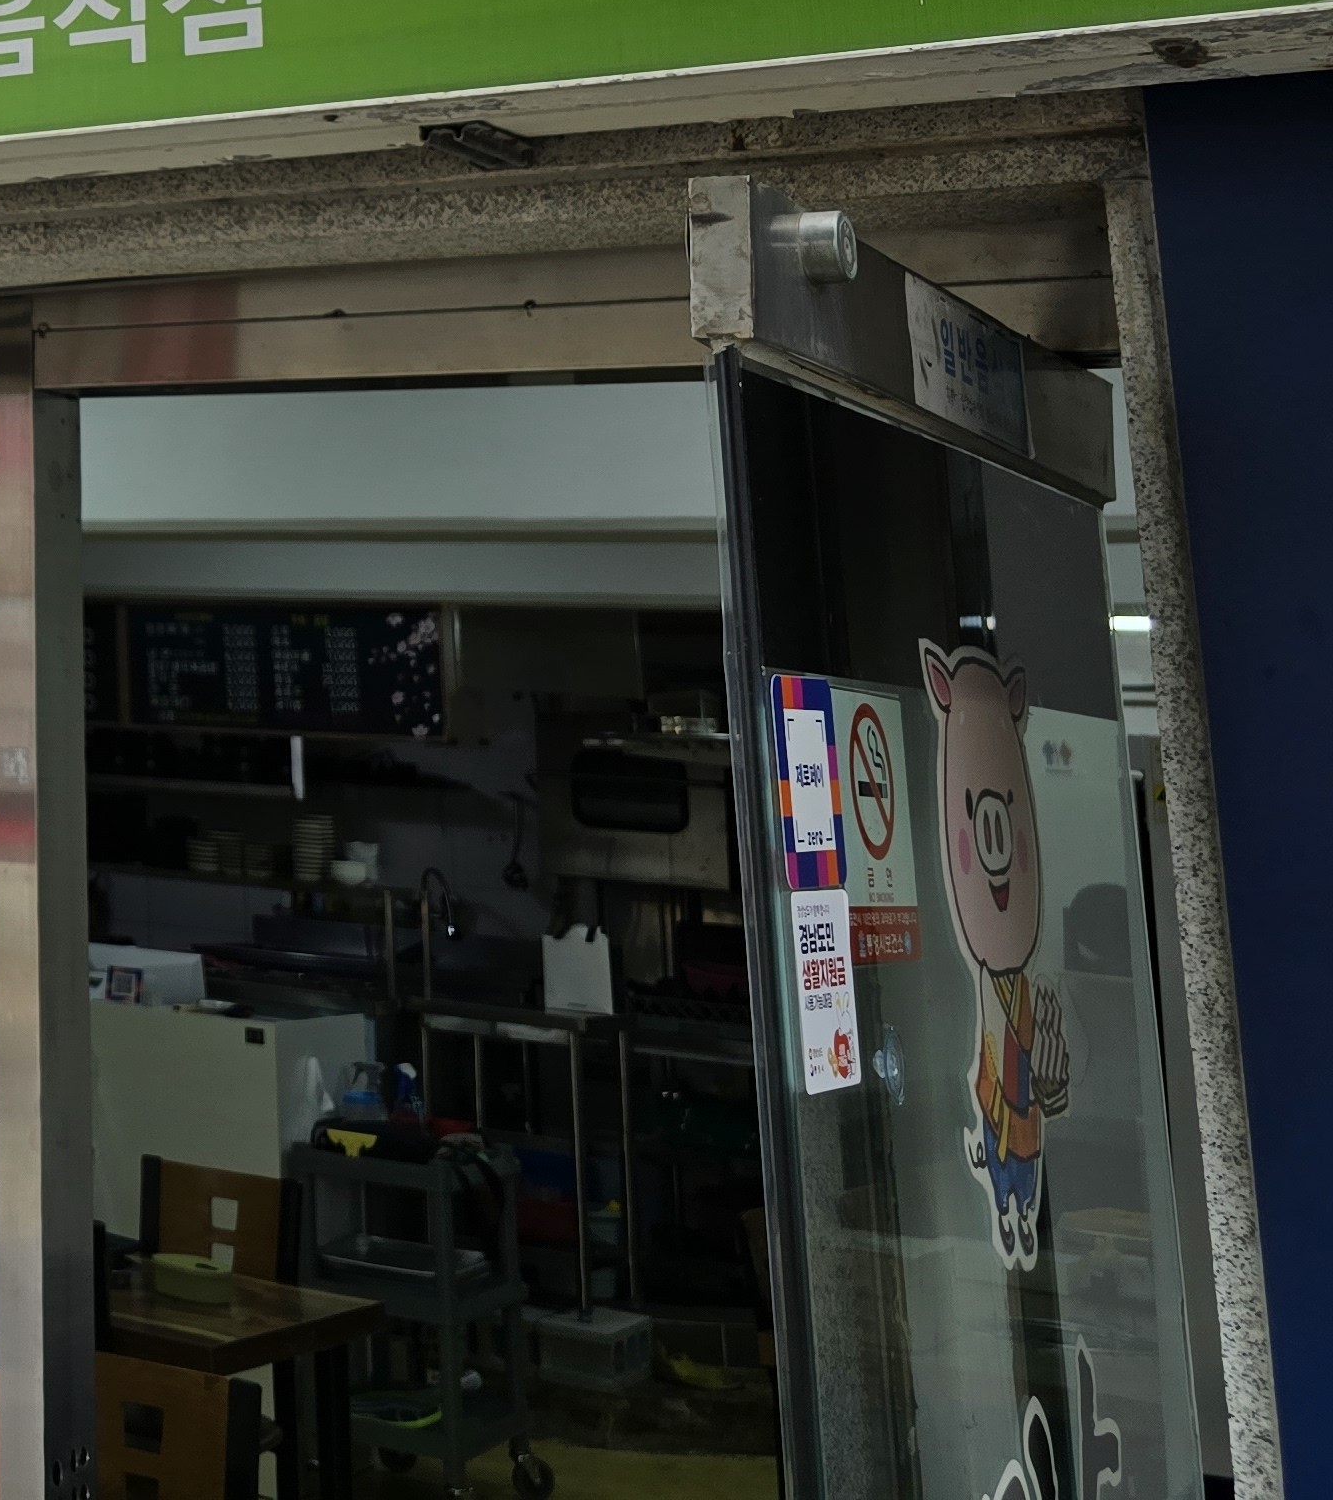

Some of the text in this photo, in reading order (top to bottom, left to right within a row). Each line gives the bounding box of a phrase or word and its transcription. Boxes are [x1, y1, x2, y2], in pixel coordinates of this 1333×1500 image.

[795, 762, 825, 788] 제로페이
[798, 922, 835, 954] 경남도민
[802, 957, 846, 990] 생활지원금
